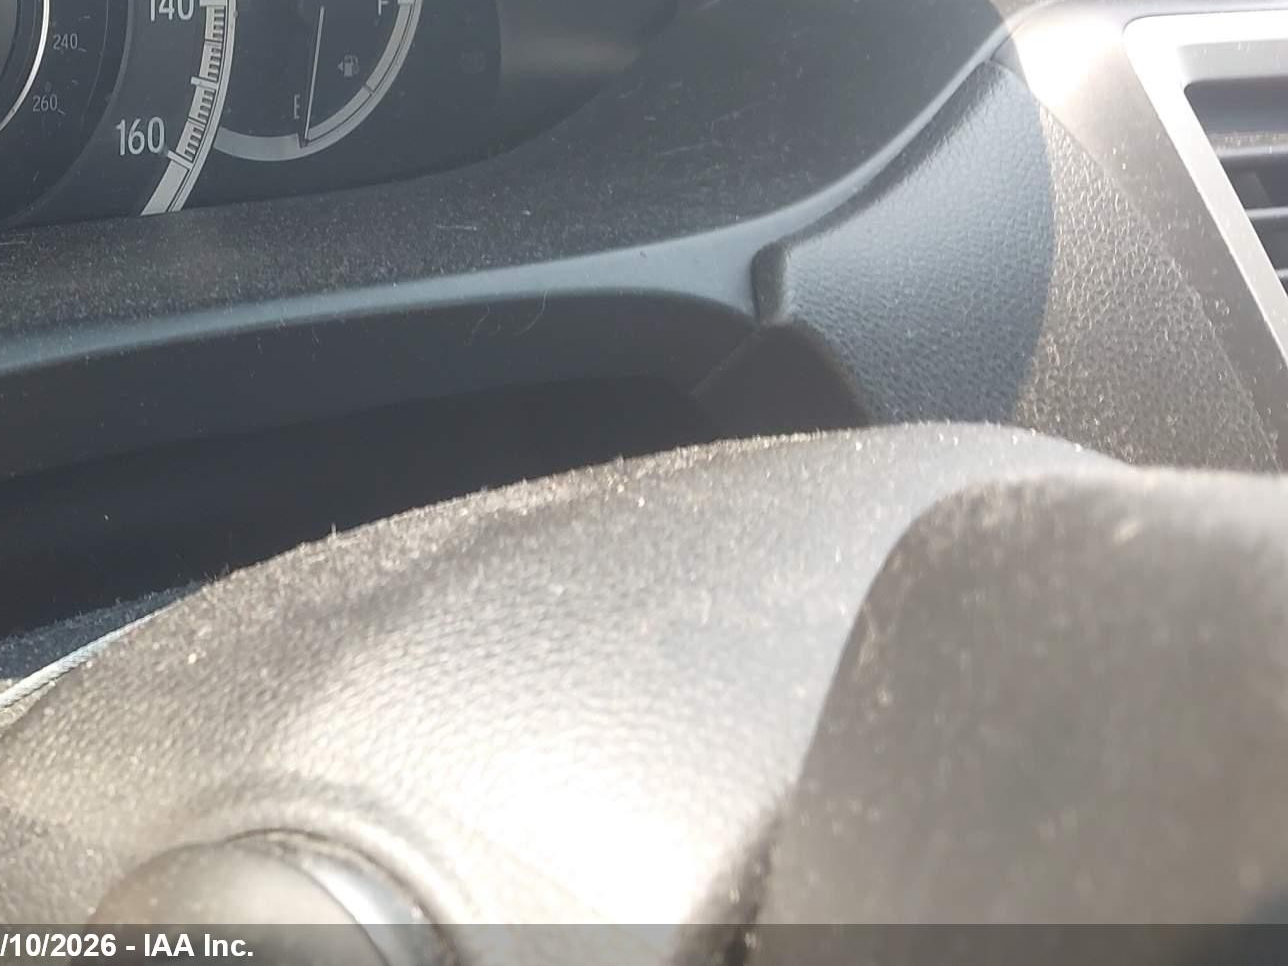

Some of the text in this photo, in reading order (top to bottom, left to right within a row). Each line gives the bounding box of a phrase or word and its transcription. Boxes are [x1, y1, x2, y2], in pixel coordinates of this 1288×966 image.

[52, 33, 78, 51] 240
[32, 94, 58, 112] 260
[294, 94, 301, 120] E
[116, 116, 165, 156] 160
